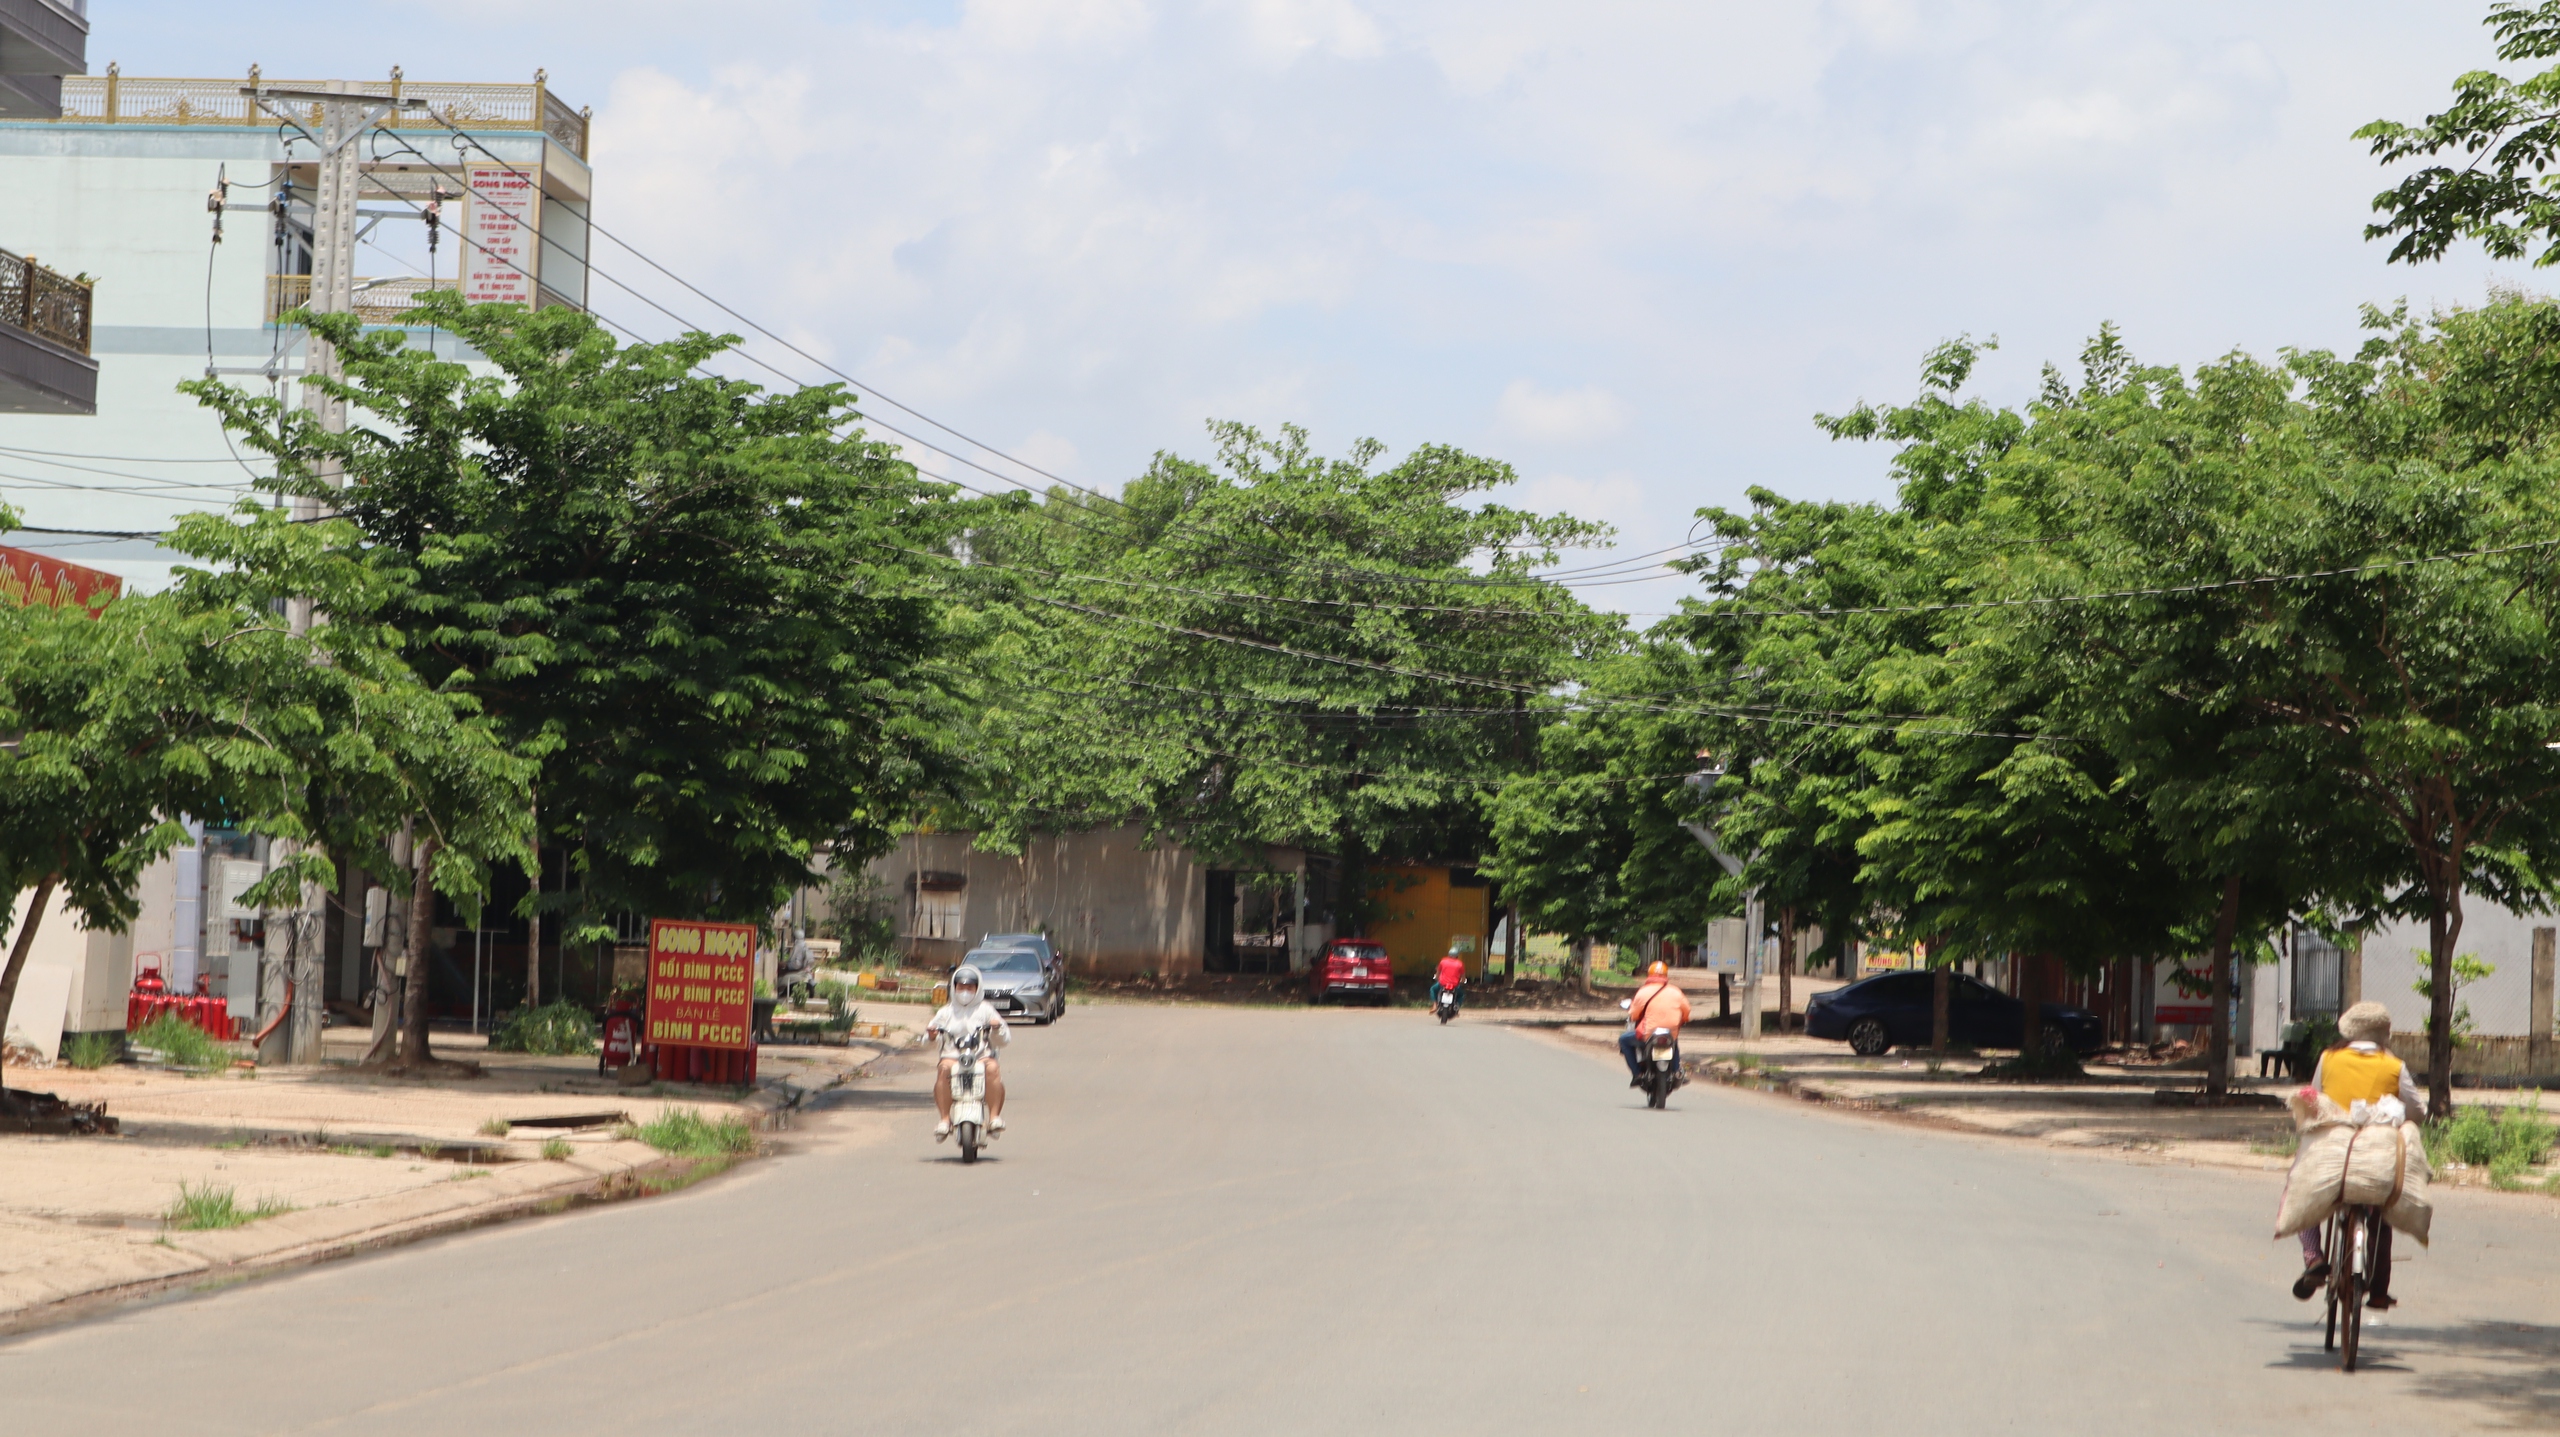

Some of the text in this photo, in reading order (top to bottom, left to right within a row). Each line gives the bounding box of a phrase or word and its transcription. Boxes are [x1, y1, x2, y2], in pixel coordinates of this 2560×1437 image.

[473, 180, 530, 191] SONG NGỌC
[657, 927, 748, 963] SONG NGỌC
[683, 960, 711, 980] BÌNH
[714, 964, 744, 982] PCCC
[655, 982, 745, 1005] NẠP BÌNH PCCC
[652, 1017, 693, 1040] BÌNH
[698, 1023, 742, 1044] PCCC
